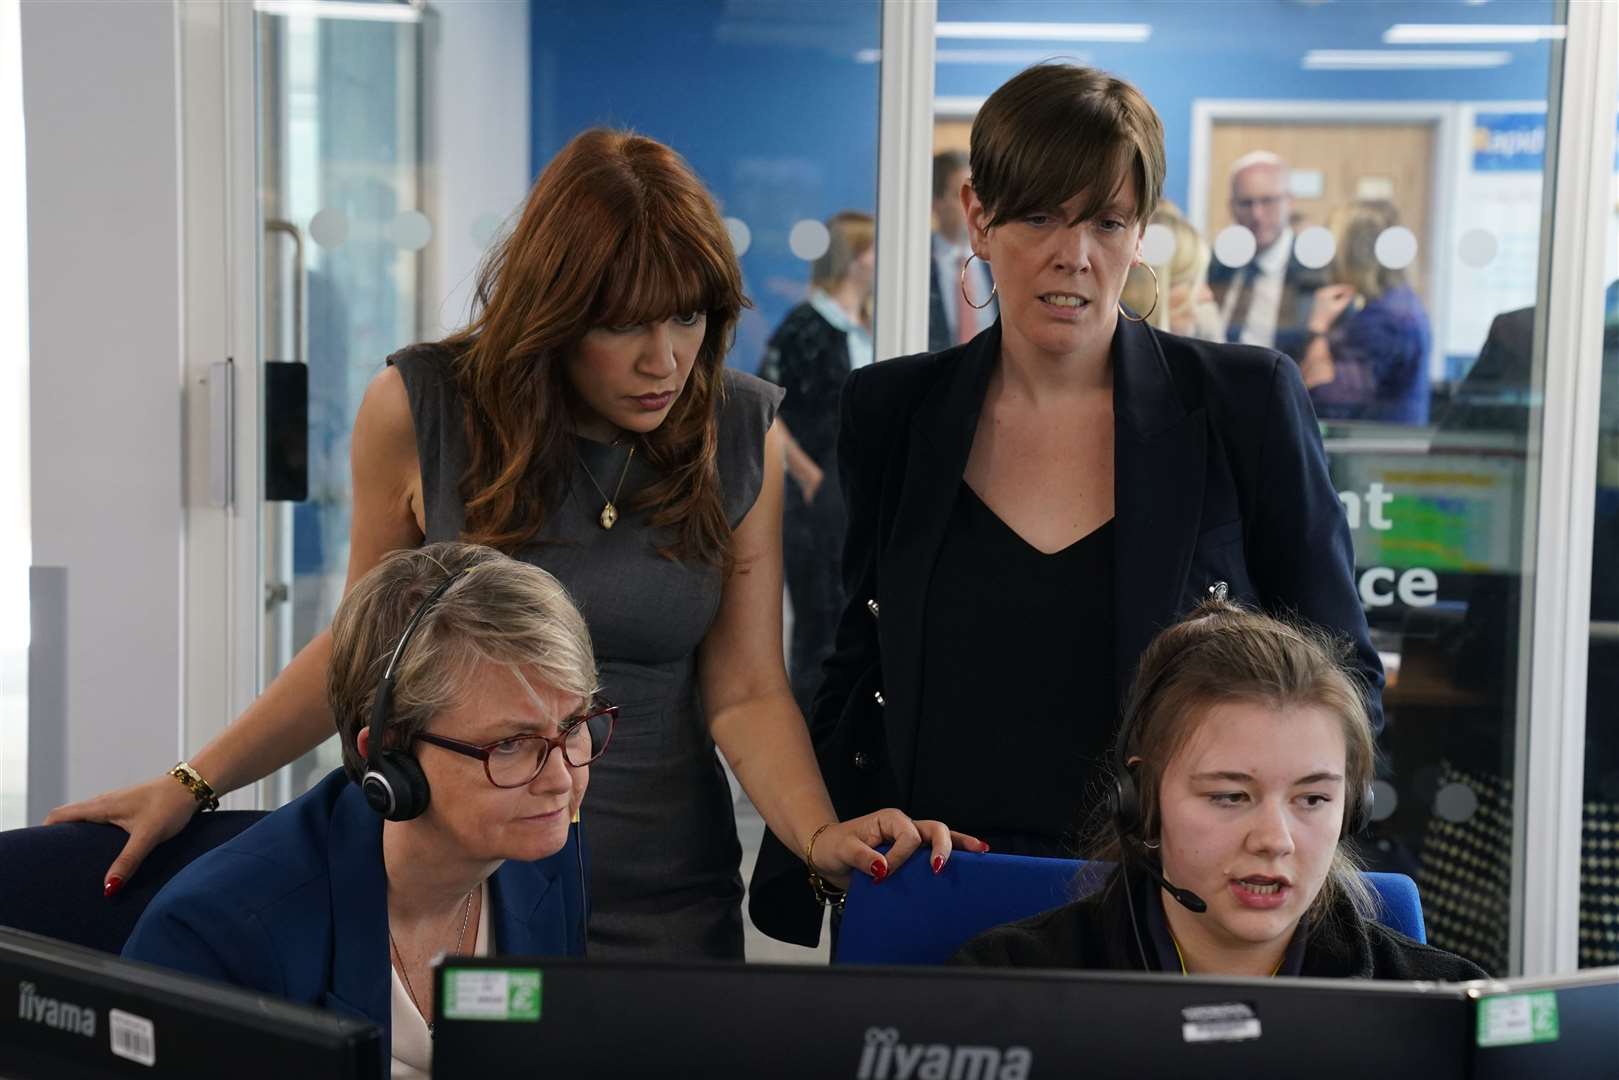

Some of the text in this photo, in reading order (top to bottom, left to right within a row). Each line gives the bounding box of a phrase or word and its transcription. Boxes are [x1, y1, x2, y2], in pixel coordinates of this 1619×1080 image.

[1359, 566, 1439, 607] ce
[18, 980, 97, 1037] iiyama
[857, 1026, 1033, 1080] iiyama
